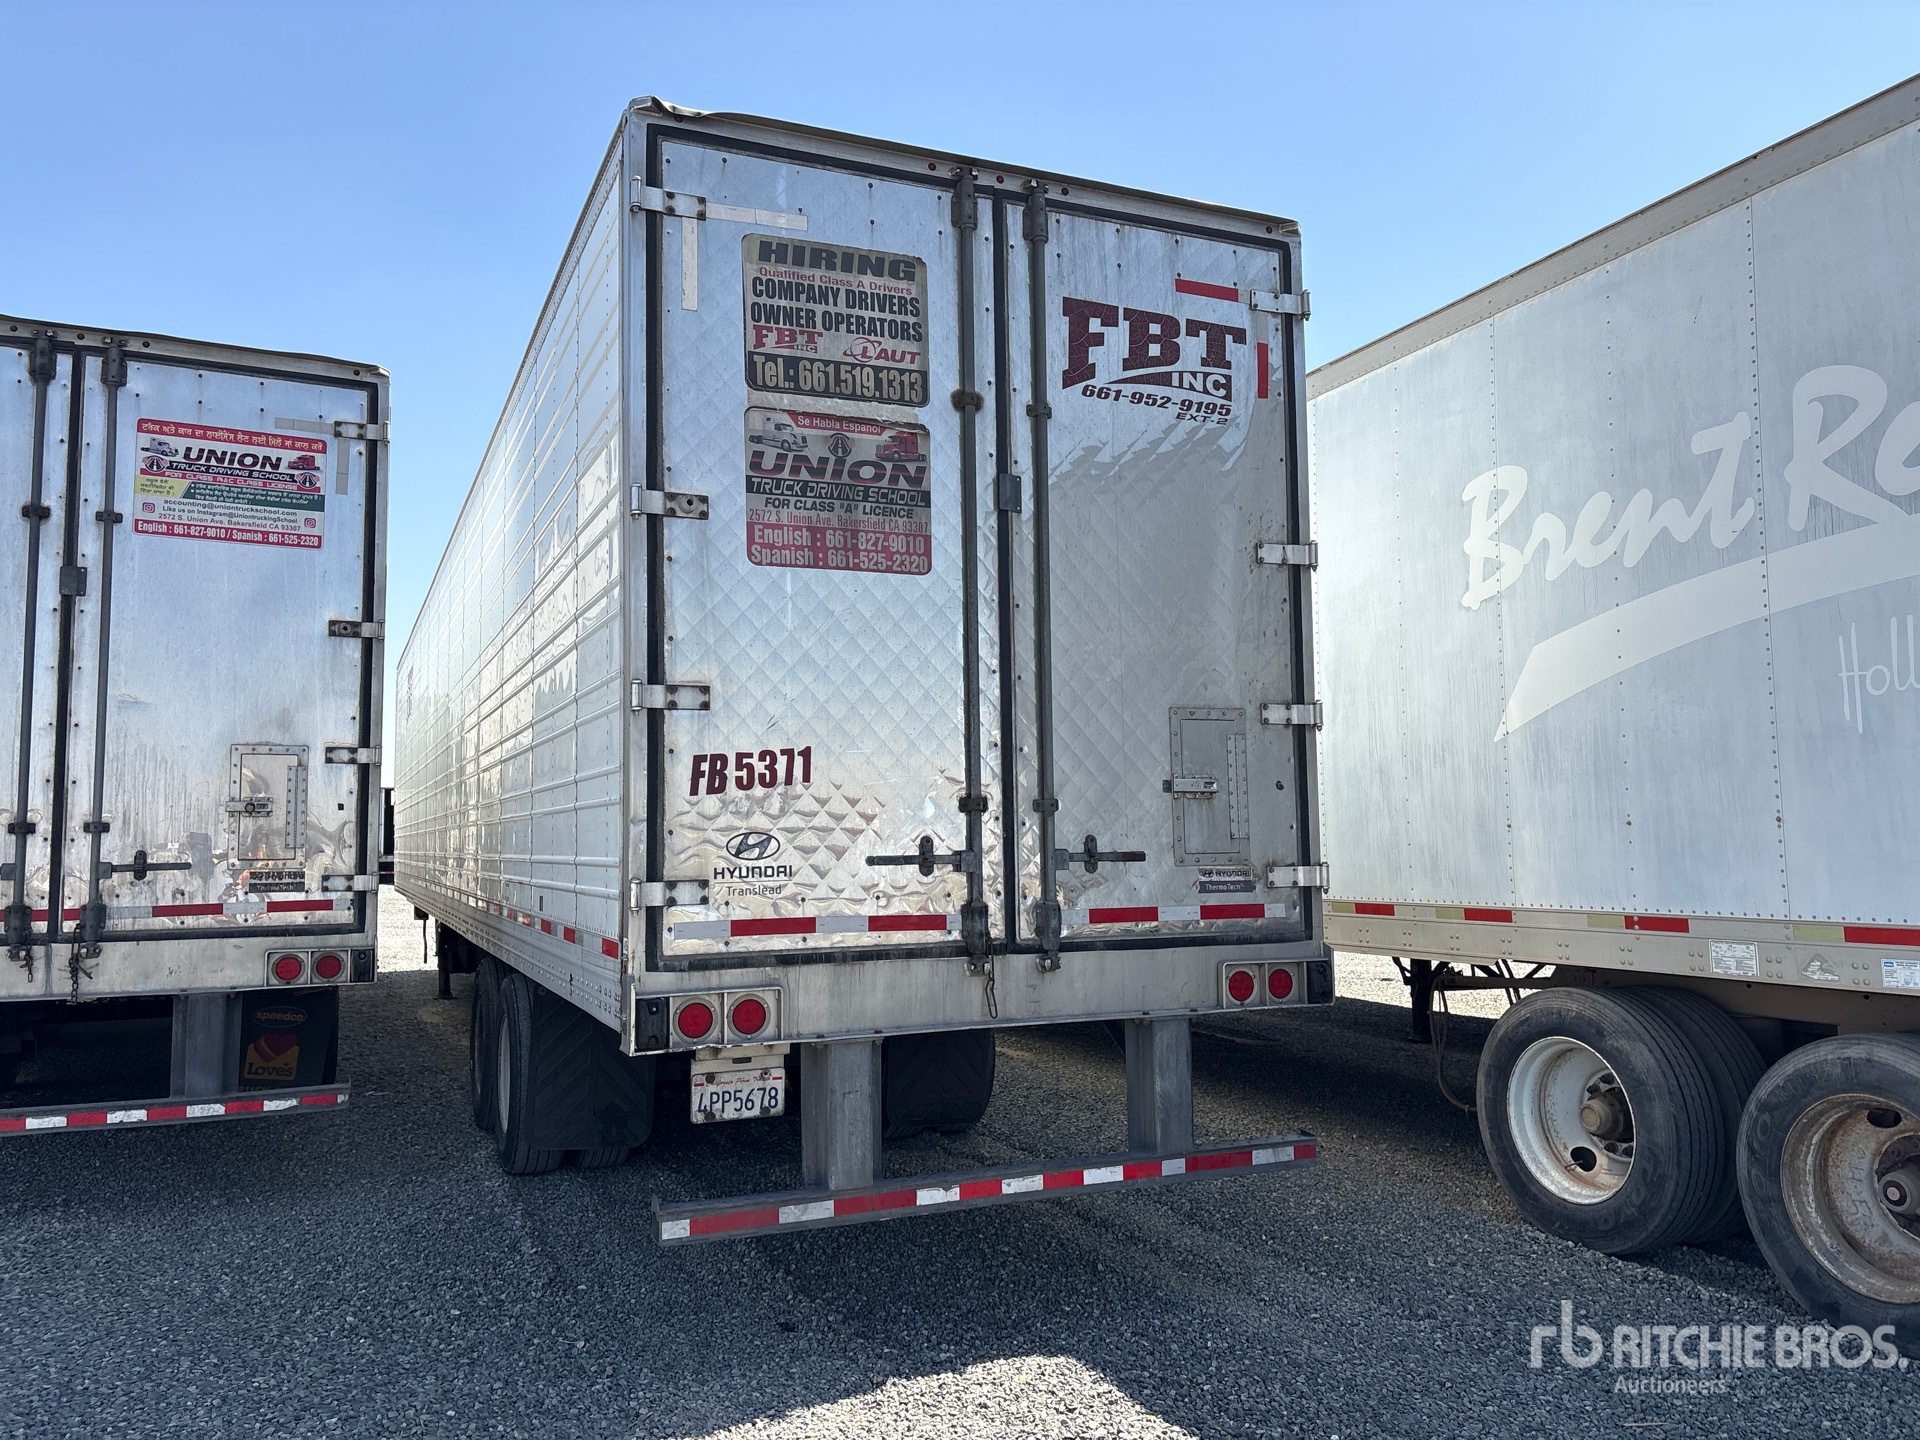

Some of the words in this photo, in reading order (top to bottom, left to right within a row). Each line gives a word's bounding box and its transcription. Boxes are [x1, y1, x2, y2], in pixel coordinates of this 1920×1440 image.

[759, 240, 916, 282] HIRING
[759, 267, 815, 283] Qualified
[820, 275, 853, 288] Class
[857, 280, 866, 289] A
[869, 281, 912, 295] Drivers
[752, 276, 840, 307] COMPANY
[845, 288, 921, 318] DRIVERS
[750, 301, 817, 330] OWNER
[821, 310, 923, 343] OPERATORS
[753, 324, 824, 350] FBT
[793, 344, 817, 353] INC
[1062, 296, 1247, 390] FBT
[753, 355, 795, 389] Tel.:
[798, 359, 923, 403] 661.519.1313
[1171, 372, 1228, 397] INC
[1081, 384, 1232, 417] 661-952-9195
[797, 415, 811, 426] Se
[813, 416, 840, 429] Habla
[1175, 412, 1228, 426] EXT-2
[183, 446, 283, 471] UNION
[749, 450, 927, 489] UNION
[165, 471, 183, 479] FOR
[185, 473, 214, 482] CLASS
[237, 479, 263, 487] CLASS
[267, 481, 298, 491] LICENSE
[172, 463, 206, 473] TRUCK
[209, 467, 250, 477] DRIVING
[252, 471, 293, 481] SCHOOL
[752, 477, 803, 496] TRUCK
[806, 482, 864, 501] DRIVING
[867, 490, 926, 506] SCHOOL
[162, 505, 176, 513] Like
[163, 498, 298, 517] accounting@uniontruckschool.com
[764, 497, 790, 509] FOR
[794, 499, 835, 513] CLASS
[839, 503, 859, 514] "A"
[862, 505, 914, 519] LICENCE
[1460, 411, 1755, 610] Brent
[138, 521, 167, 533] English
[173, 525, 226, 537] 661-827-9010
[232, 530, 263, 541] Spanish
[268, 533, 319, 546] 661-525-2320
[158, 513, 176, 521] 2572
[187, 516, 208, 524] Union
[227, 519, 267, 529] Bakersfield
[749, 509, 772, 522] 2572
[775, 511, 784, 523] S.
[786, 511, 812, 525] Union
[815, 513, 835, 527] Ave.
[837, 514, 886, 530] Bakersfield
[888, 519, 900, 532] CA
[902, 521, 928, 534] 93307
[753, 525, 812, 546] English
[825, 529, 925, 554] 661-827-9010
[751, 544, 814, 566] Spanish
[827, 549, 928, 573] 661-525-2320
[713, 865, 793, 880] HYUNDAI
[726, 885, 782, 897] Translead
[697, 1086, 779, 1114] 4PP5678
